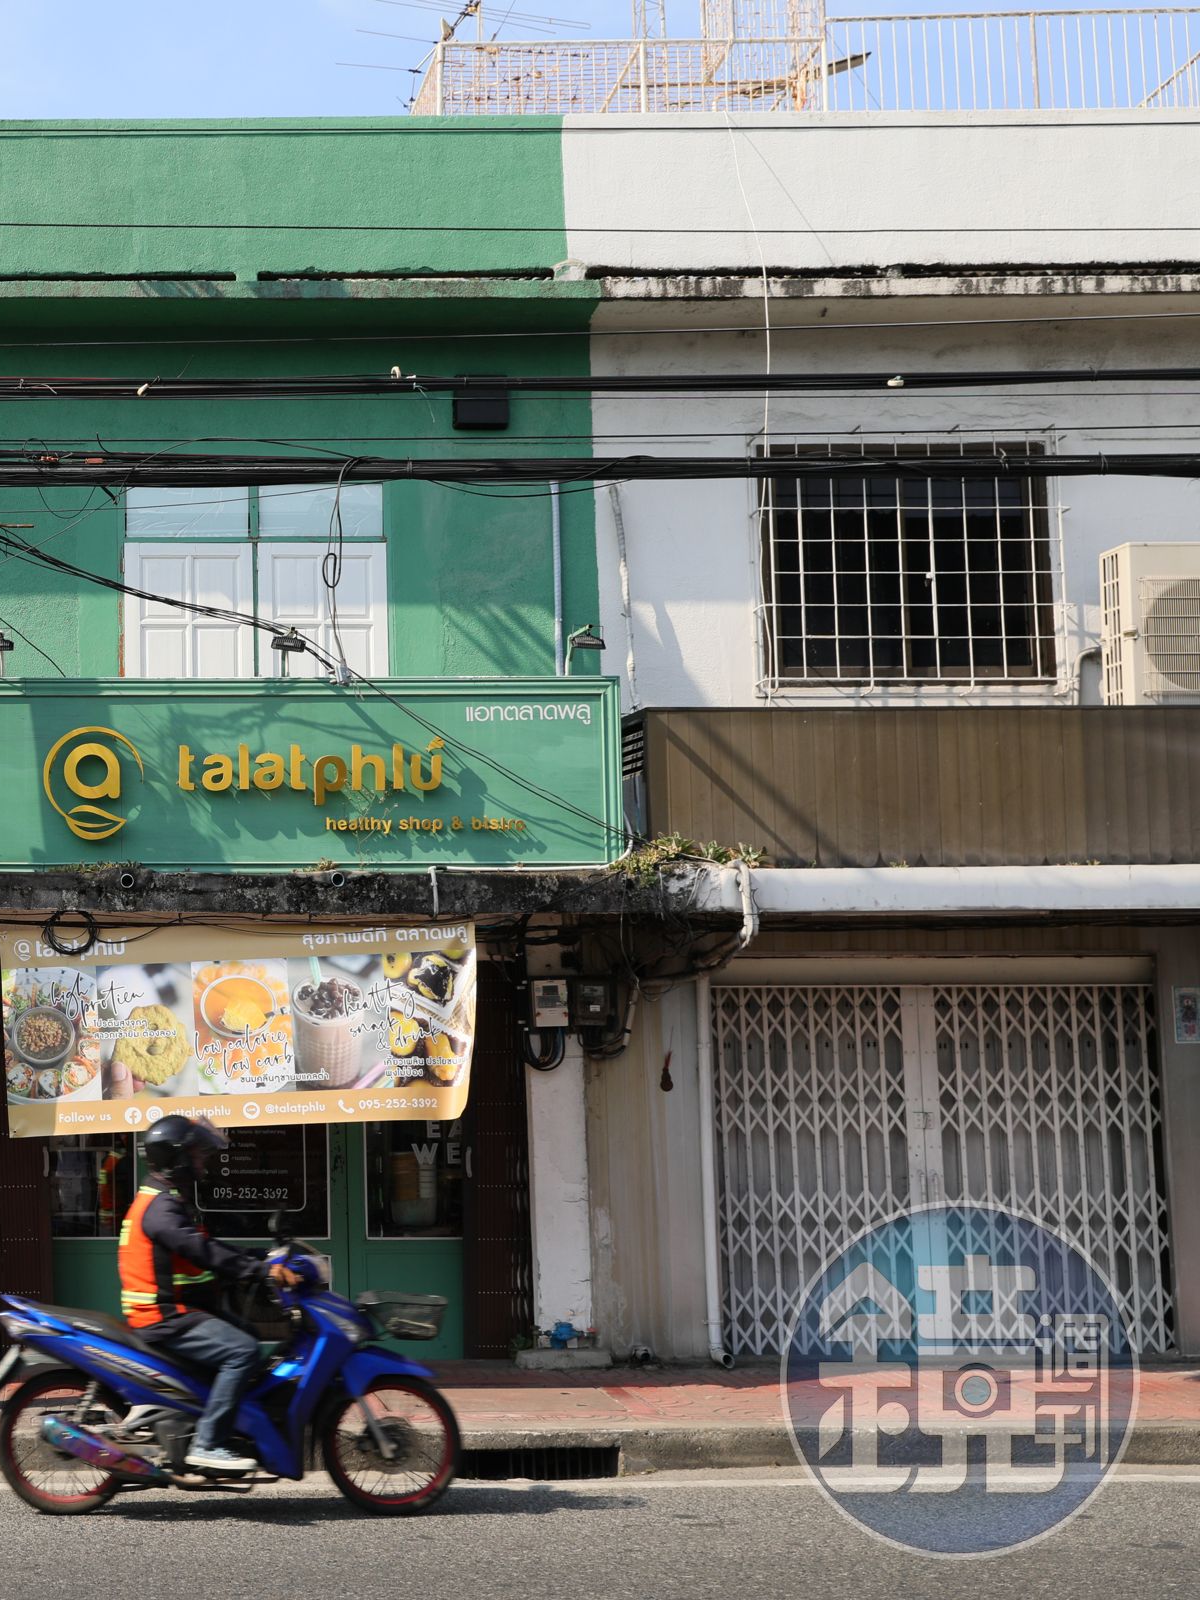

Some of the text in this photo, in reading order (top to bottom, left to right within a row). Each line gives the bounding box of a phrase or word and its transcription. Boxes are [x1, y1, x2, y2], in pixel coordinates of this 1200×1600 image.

[326, 815, 527, 834] healthy shop & bistro
[396, 925, 468, 944] ตลาดพลู
[51, 972, 88, 1019] high
[349, 1006, 400, 1037] snack
[394, 1017, 441, 1047] drink
[195, 1023, 286, 1060] low calorie
[223, 1049, 250, 1077] low
[256, 1042, 293, 1066] carb
[58, 1113, 96, 1123] Follow
[100, 1113, 111, 1121] us
[265, 1101, 326, 1115] @talatphlu
[358, 1098, 438, 1110] 095-252-3392
[213, 1187, 289, 1199] 095-252-3392
